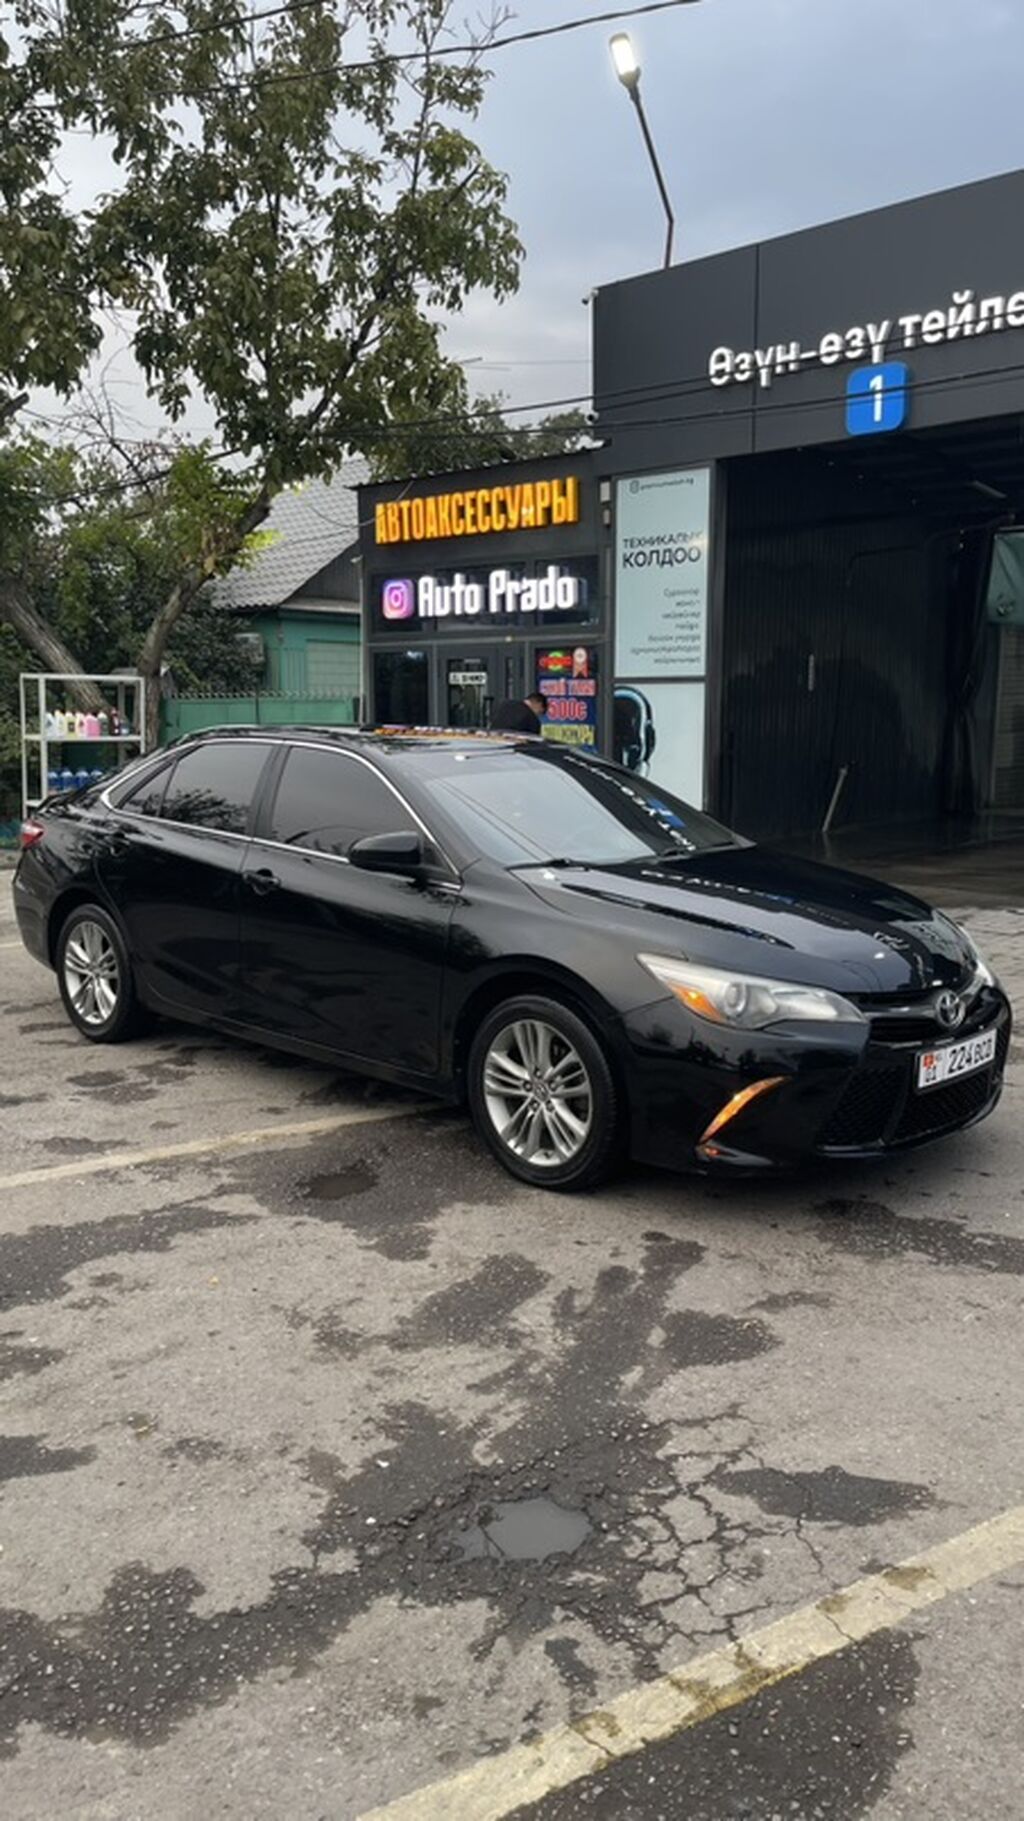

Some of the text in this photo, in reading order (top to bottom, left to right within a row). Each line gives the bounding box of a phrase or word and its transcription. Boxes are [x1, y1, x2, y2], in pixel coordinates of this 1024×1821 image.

[898, 289, 1024, 348] тейле
[869, 374, 884, 422] 1
[374, 476, 580, 544] АВТОАКСЕССУАРЫ
[622, 546, 701, 569] КОЛДОО
[418, 565, 578, 617] Auto Prado
